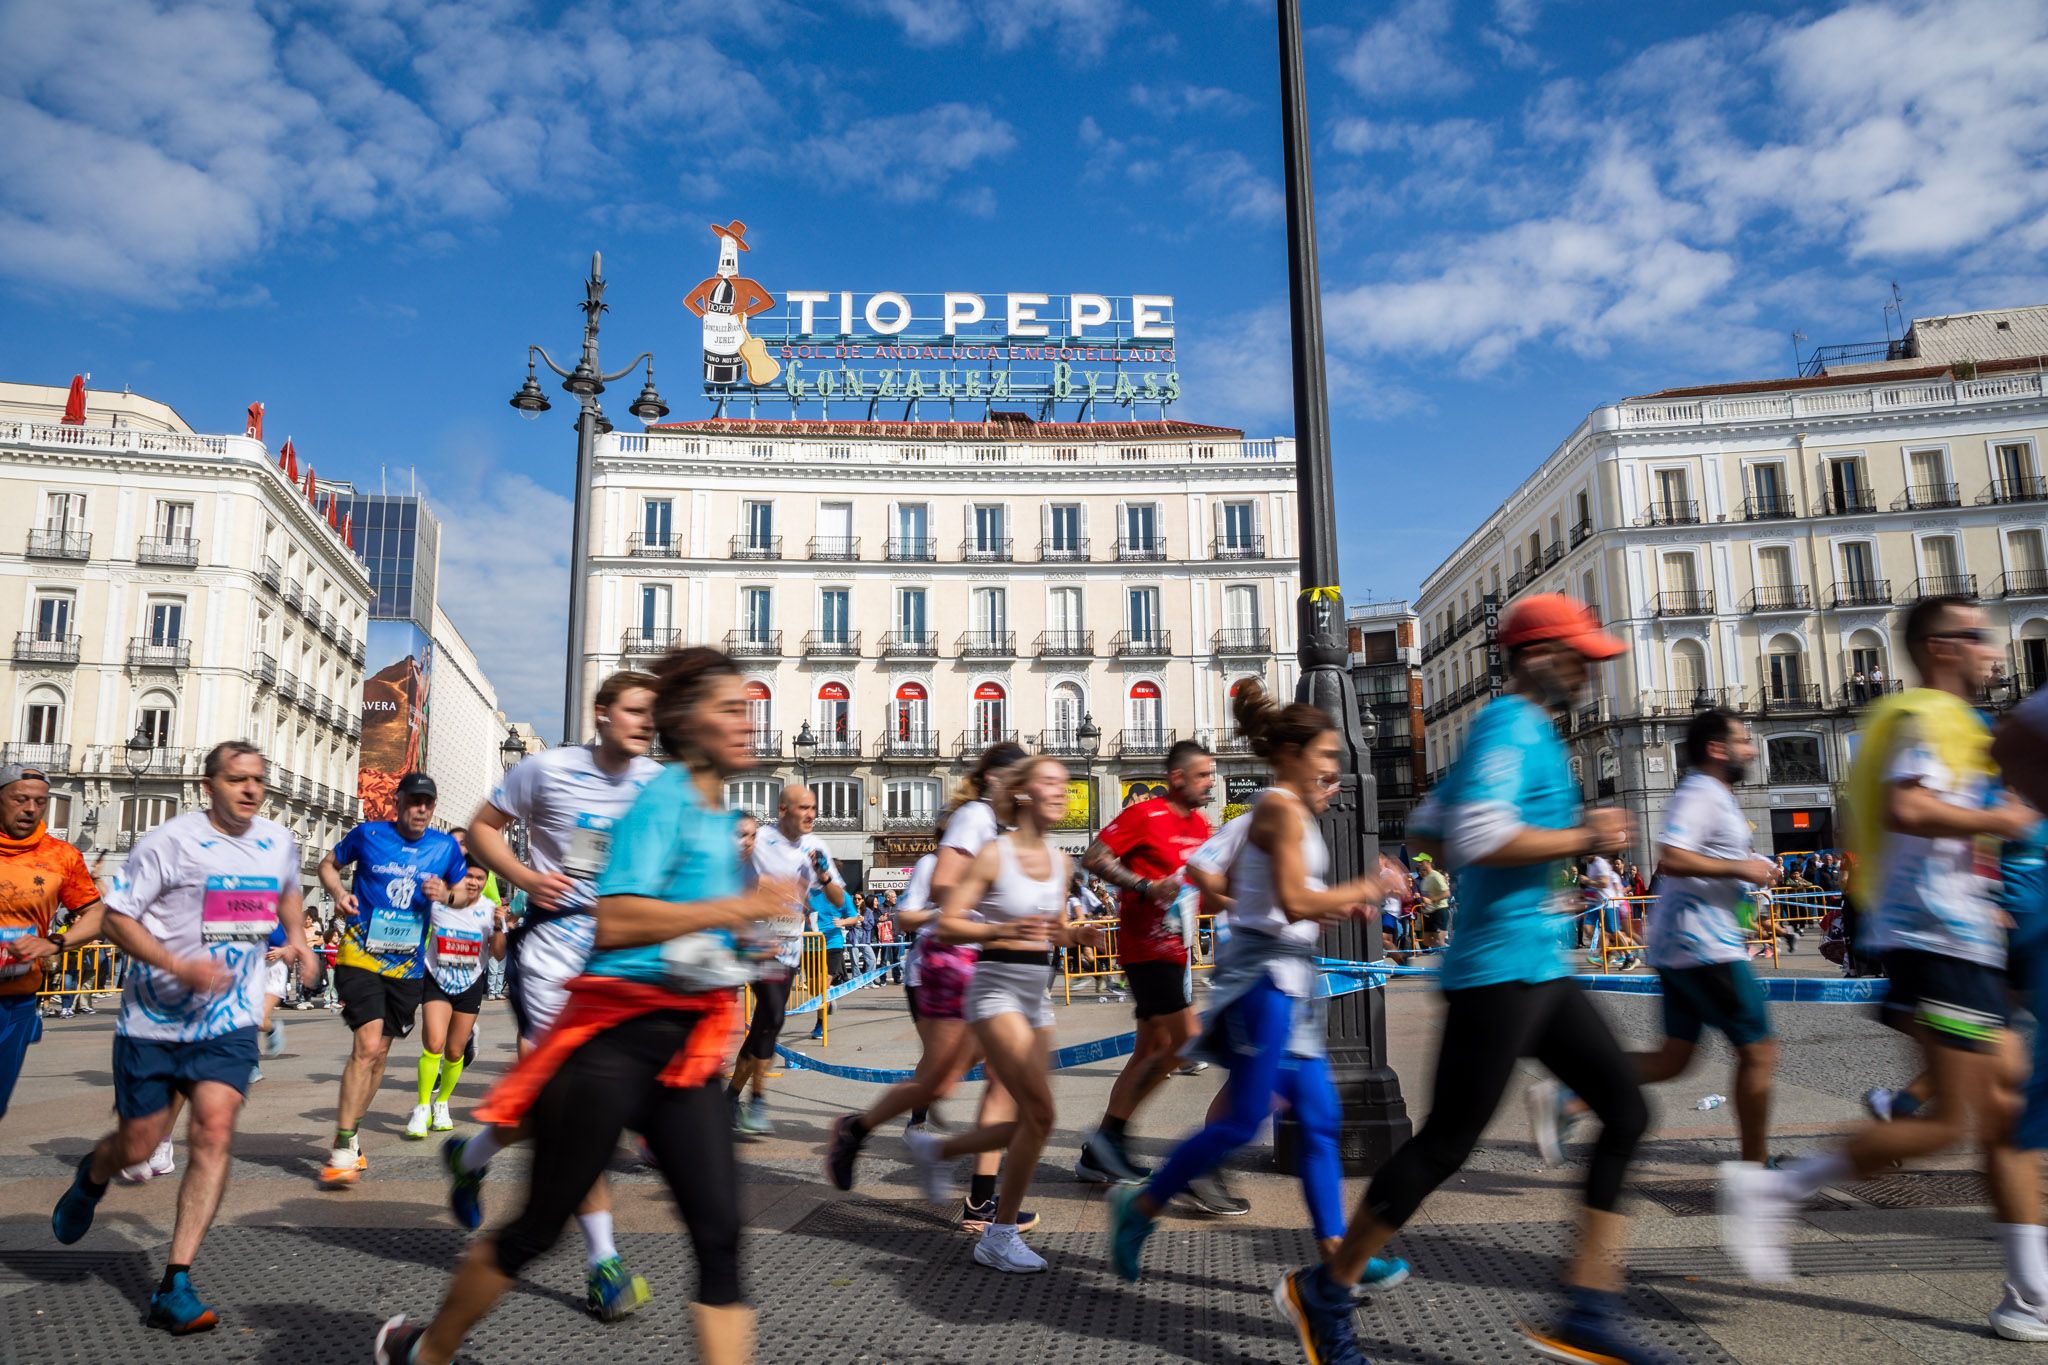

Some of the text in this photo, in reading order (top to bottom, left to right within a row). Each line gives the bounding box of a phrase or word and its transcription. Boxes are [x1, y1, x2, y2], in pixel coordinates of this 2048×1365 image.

[786, 290, 1175, 338] TIO PEPE
[714, 336, 735, 344] JEREZ
[779, 345, 1176, 362] SOL DE ANDALUCIA EMBOTELLADO
[785, 359, 1181, 399] GONZALEZ BYASS
[1484, 603, 1500, 666] HOTEL
[383, 926, 411, 937] 13977
